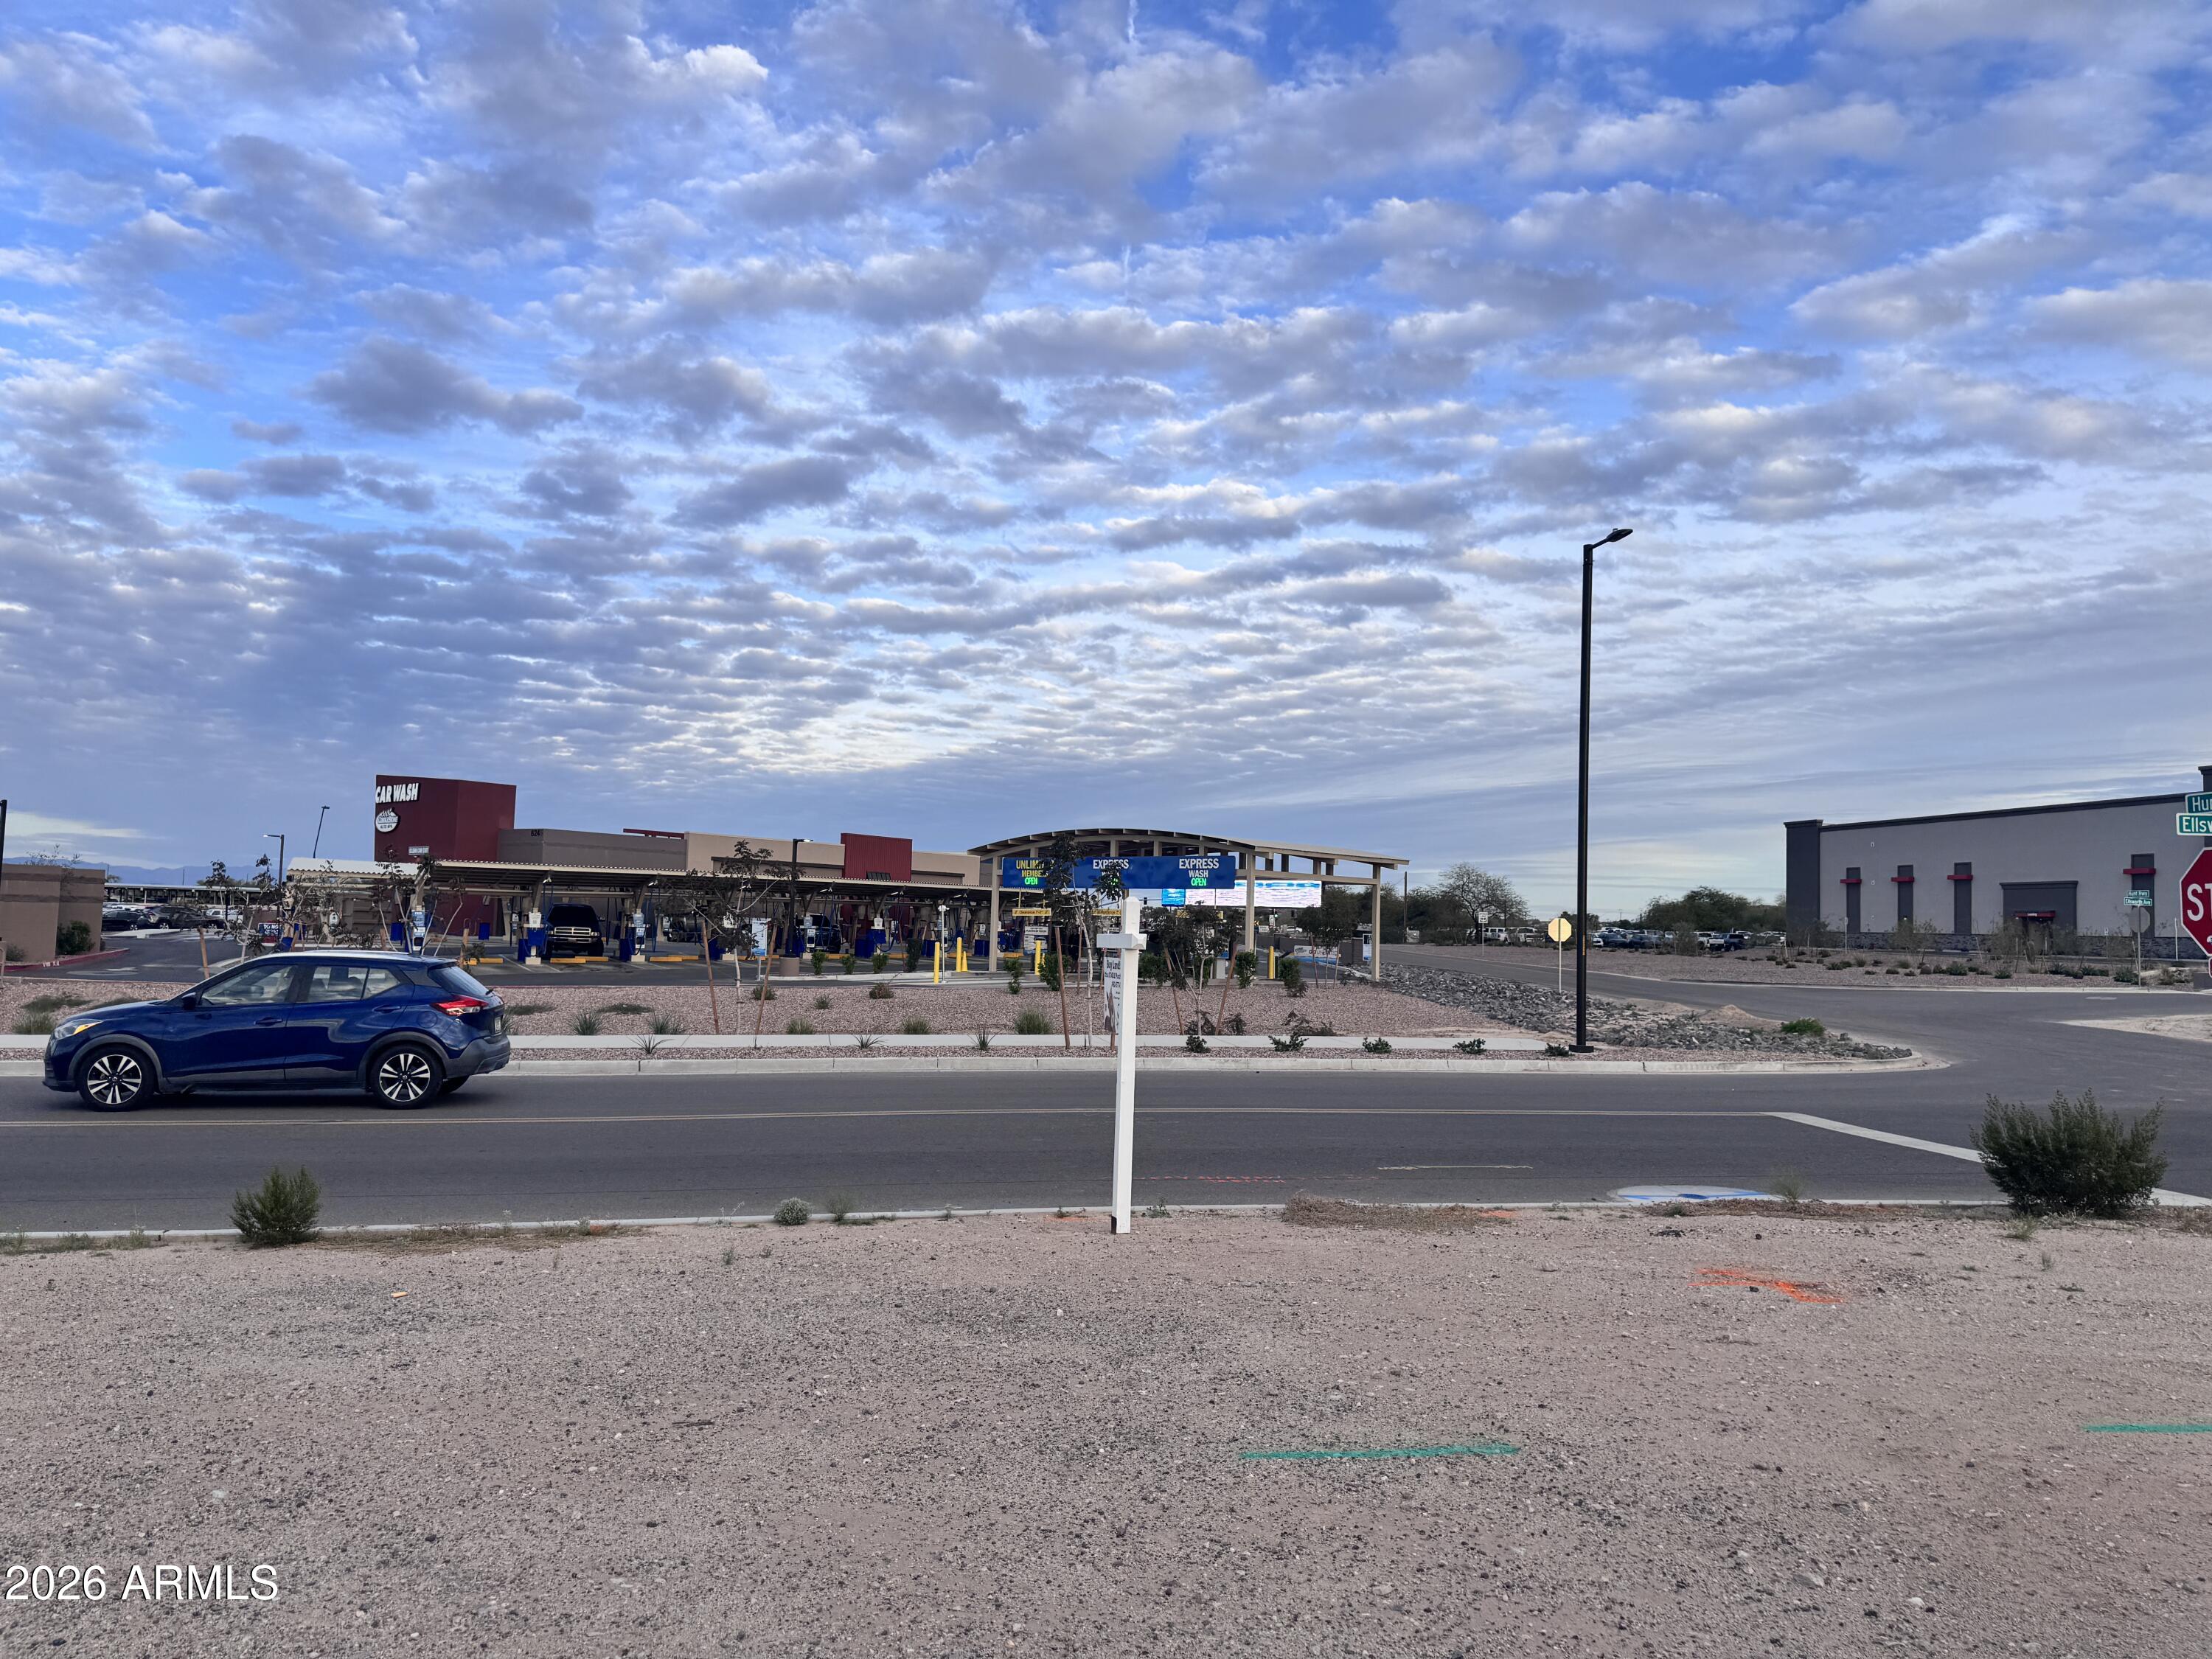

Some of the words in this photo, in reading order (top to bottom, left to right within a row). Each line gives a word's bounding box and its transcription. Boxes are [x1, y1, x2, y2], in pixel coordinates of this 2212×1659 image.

[375, 785, 392, 804] CAR
[393, 783, 419, 802] WASH
[2192, 796, 2212, 812] Hu
[1179, 858, 1220, 869] EXPRESS
[1189, 869, 1208, 878] WASH
[1191, 877, 1207, 886] OPEN
